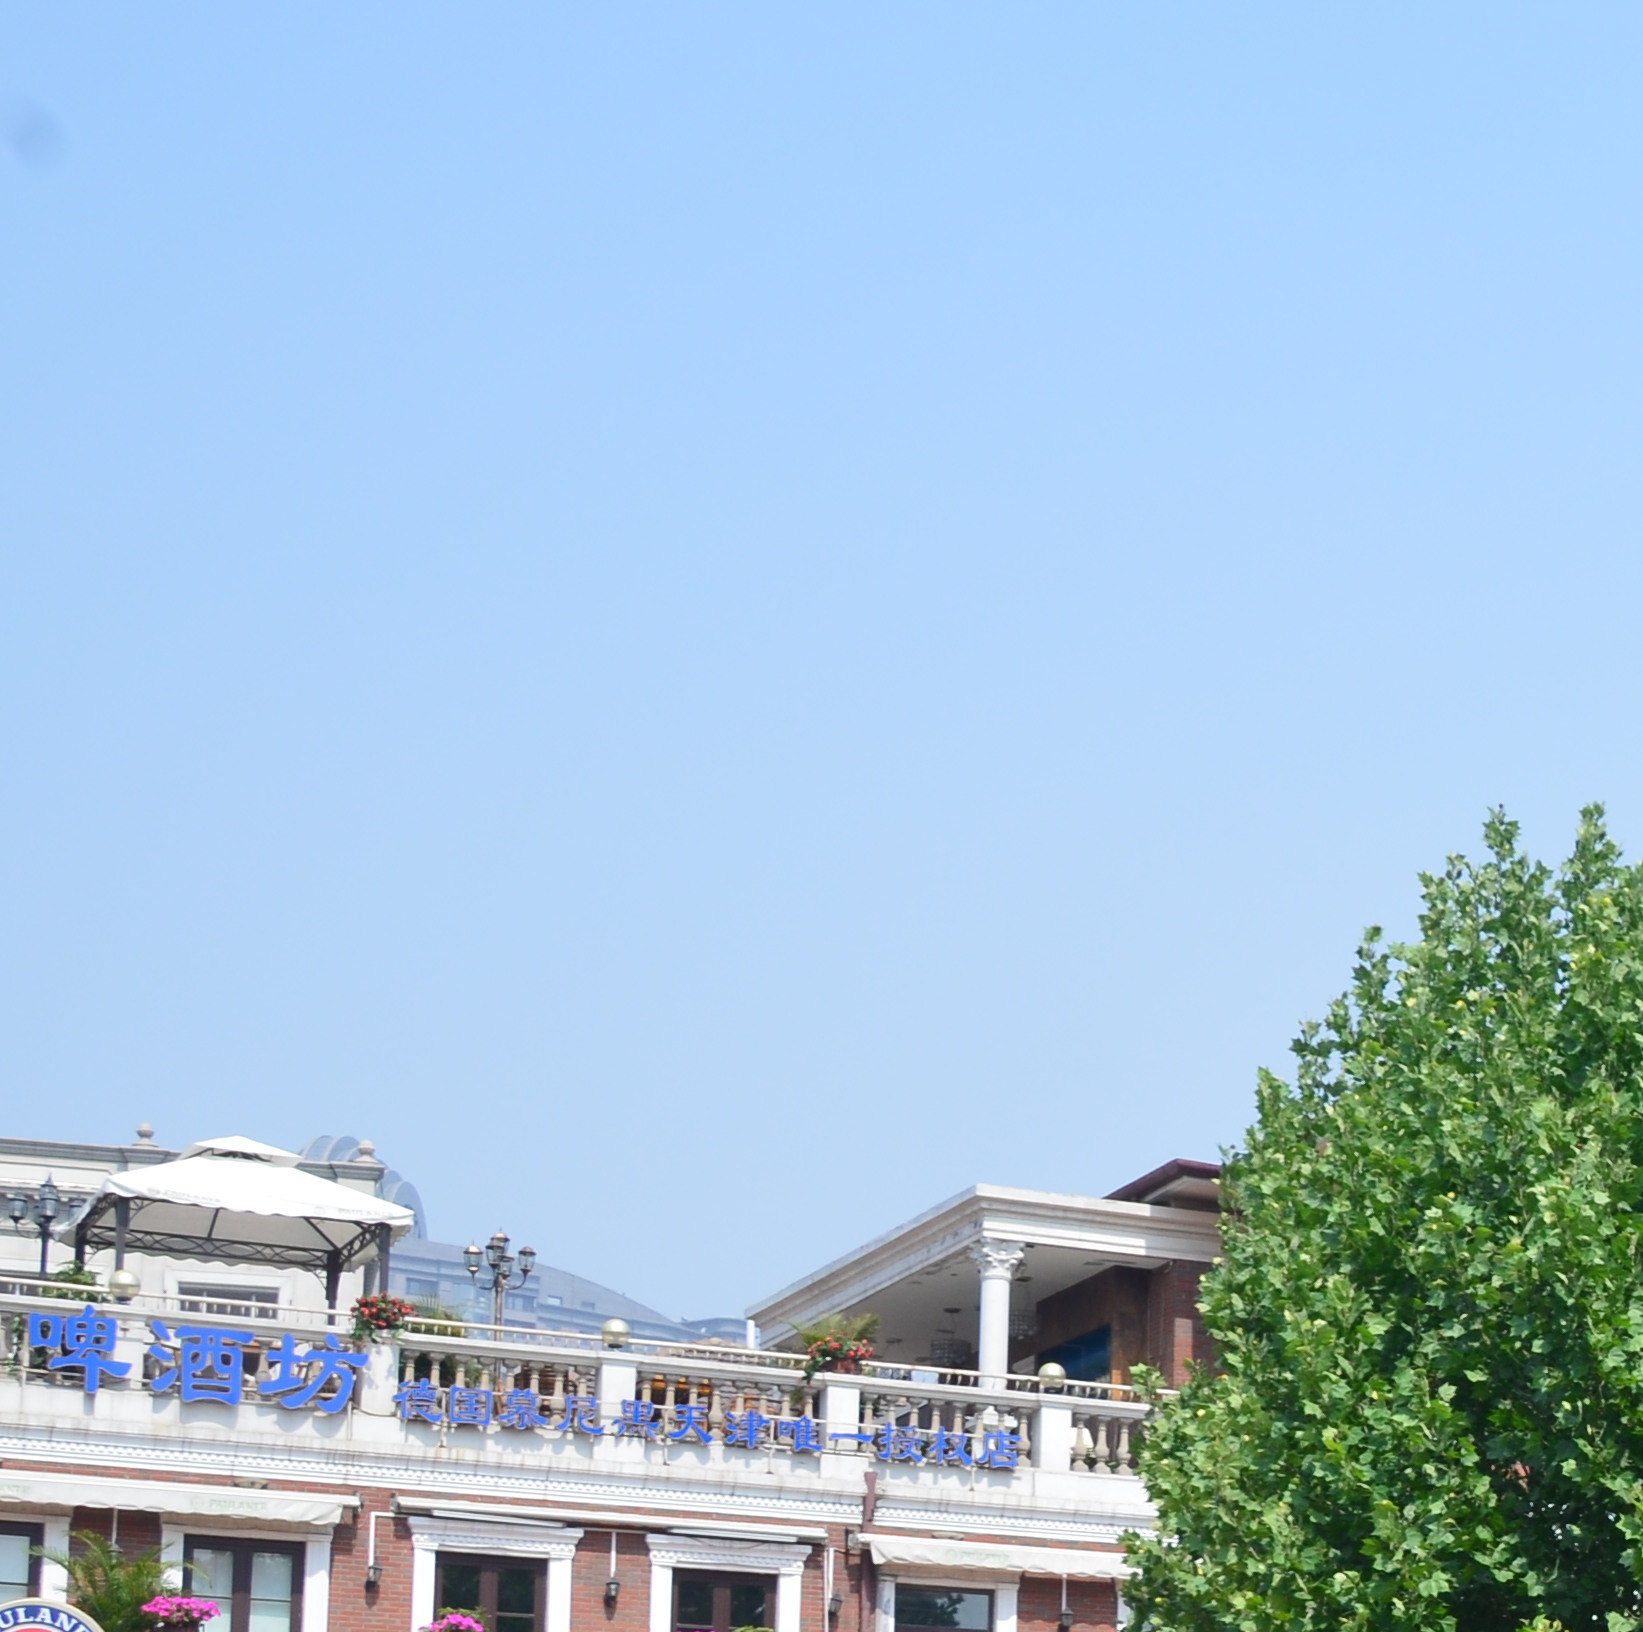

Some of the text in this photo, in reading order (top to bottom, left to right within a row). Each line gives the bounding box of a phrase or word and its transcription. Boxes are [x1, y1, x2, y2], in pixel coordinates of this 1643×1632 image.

[29, 1305, 369, 1414] 啤酒坊
[394, 1378, 1023, 1469] 德国慕尼黑天津唯一授权店
